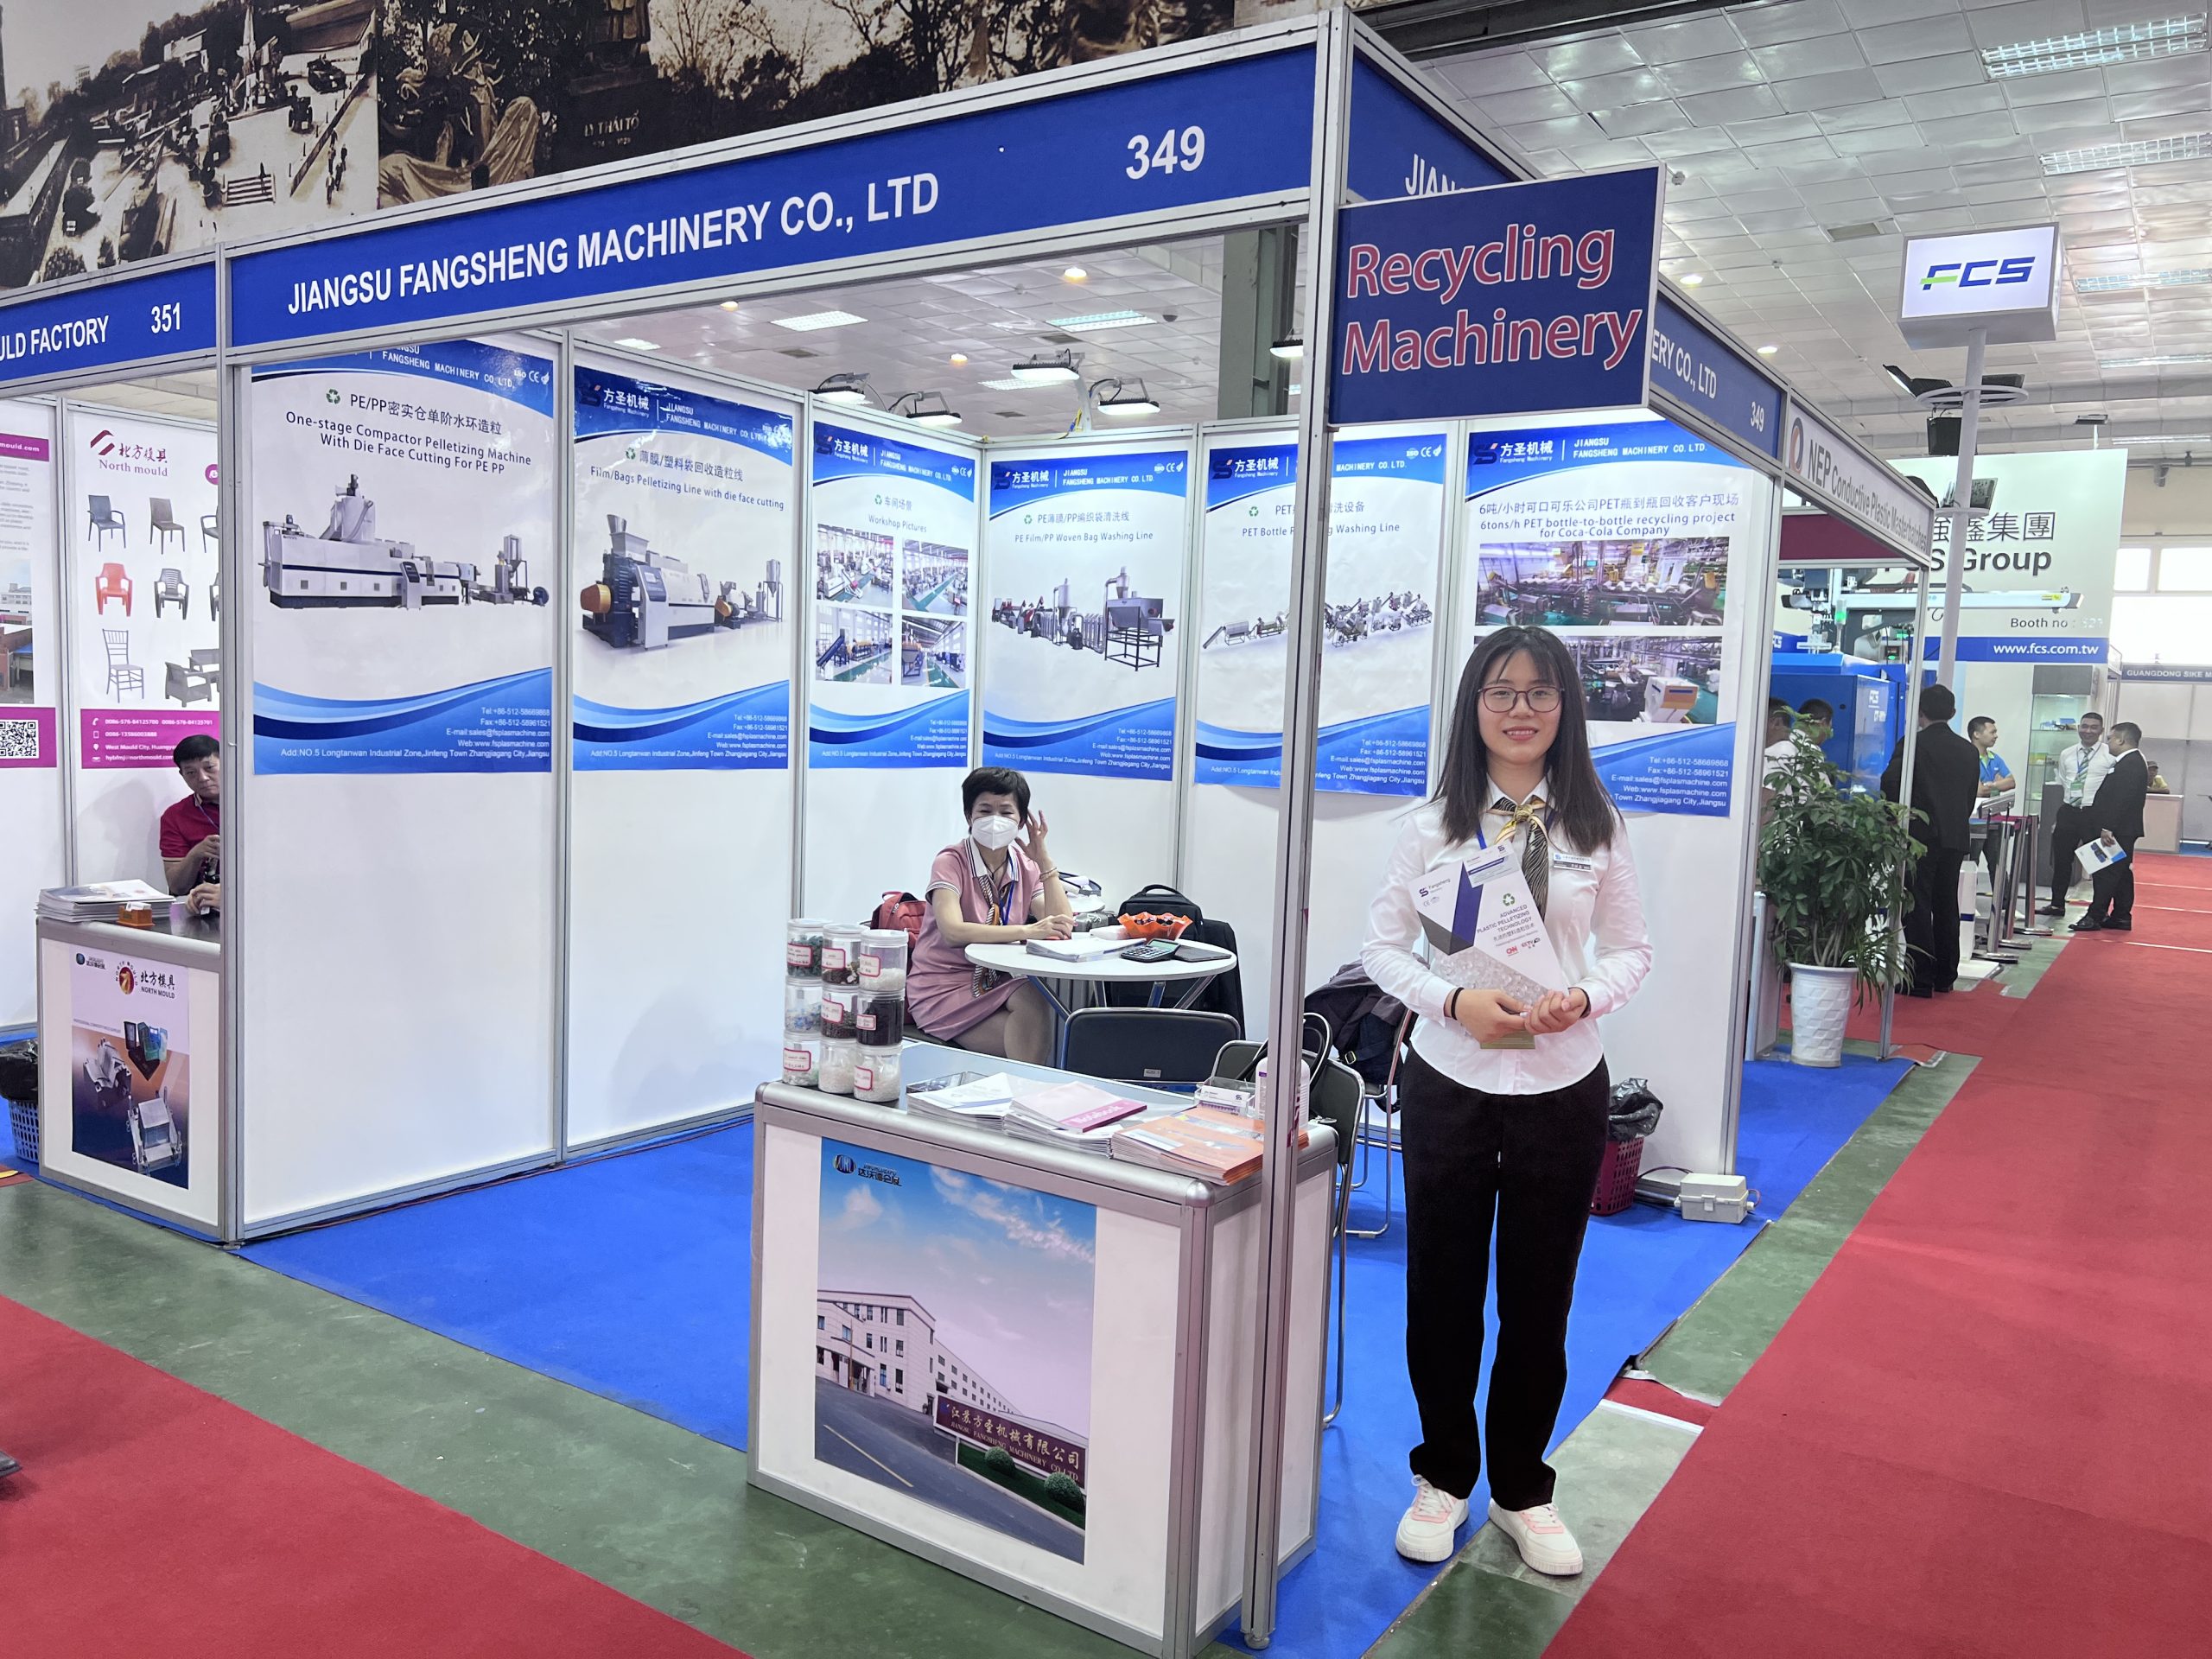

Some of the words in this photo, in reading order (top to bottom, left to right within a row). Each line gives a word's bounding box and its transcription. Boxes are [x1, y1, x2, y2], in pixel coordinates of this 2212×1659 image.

[288, 268, 391, 315] JIANGSU
[399, 238, 568, 297] FANGSHENG
[578, 200, 772, 270] MACHINERY
[780, 191, 853, 235] CO.,
[868, 173, 939, 222] LTD
[1125, 125, 1205, 180] 349
[1347, 223, 1614, 304] Recycling
[1920, 257, 2036, 290] FCS
[31, 315, 110, 355] FACTORY
[151, 302, 181, 334] 351
[1342, 308, 1643, 375] Machinery
[382, 351, 430, 370] FANGSHENG
[435, 363, 480, 380] MACHINERY
[1675, 347, 1696, 391] CO.,
[1698, 363, 1717, 400] LTD
[1750, 401, 1764, 433] 349
[604, 389, 649, 410] 方圣机械
[350, 393, 502, 436] PE/PP密实仓单阶水环造粒
[666, 413, 701, 429] FANGSHENG
[703, 422, 737, 435] MACHINERY
[286, 410, 353, 434] One-stage
[356, 423, 422, 448] Compactor
[425, 435, 484, 460] Pelletizing
[488, 447, 532, 466] Machine
[1573, 437, 1610, 448] JIANGSU
[119, 443, 168, 463] 北方模具
[320, 433, 350, 449] With
[354, 437, 374, 454] Die
[378, 442, 405, 459] Face
[409, 448, 451, 468] Cutting
[454, 456, 474, 470] For
[475, 458, 489, 473] PE
[492, 461, 505, 474] PP
[834, 438, 868, 457] 方圣机械
[1500, 440, 1554, 457] 方圣机械
[1573, 448, 1618, 458] FANGSHENG
[1623, 445, 1669, 456] MACHINERY
[99, 459, 130, 472] North
[135, 465, 168, 477] mould
[1235, 457, 1279, 473] 方圣机械
[1336, 462, 1375, 472] MACHINERY
[1012, 470, 1049, 484] 方圣机械
[1063, 477, 1094, 486] FANGSHENG
[590, 466, 635, 484] Film/Bags
[637, 474, 682, 494] Pelletizing
[683, 484, 702, 495] Line
[704, 486, 722, 499] with
[724, 490, 737, 502] die
[739, 493, 754, 505] face
[757, 497, 785, 512] cutting
[1808, 440, 1831, 489] NEP
[1832, 465, 1870, 516] Conductive
[1871, 492, 1890, 529] Plastic
[1891, 506, 1927, 552] Masterbatches
[868, 514, 900, 530] Workshop
[902, 519, 927, 532] Pictures
[1243, 528, 1257, 537] PET
[1261, 526, 1287, 537] Bottle
[1337, 524, 1376, 535] Washing
[1380, 523, 1400, 532] Line
[1480, 519, 1520, 530] 6tons/h
[1524, 518, 1542, 528] PET
[1546, 515, 1633, 528] bottle-to-bottle
[1637, 513, 1688, 525] recycling
[1693, 512, 1735, 524] project
[1014, 534, 1024, 543] PE
[1026, 533, 1054, 543] Film/PP
[1056, 532, 1082, 542] Woven
[1084, 532, 1098, 543] Bag
[1100, 531, 1134, 543] Washing
[1136, 531, 1154, 540] Line
[1540, 528, 1555, 537] for
[1558, 526, 1612, 537] Coca-Cola
[1616, 525, 1669, 537] Company
[1963, 548, 2052, 576] Group
[2011, 618, 2048, 628] Booth
[1993, 642, 2099, 655] www.fcs.com.tw
[1332, 772, 1348, 780] Town
[1614, 793, 1633, 802] Town
[1634, 795, 1681, 805] Zhangjiagang
[1499, 904, 1528, 918] ADVANCED
[1477, 921, 1497, 934] PLASTIC
[1497, 910, 1530, 926] PELLETIZING
[1497, 917, 1532, 933] TECHNOLOGY
[141, 970, 175, 988] 北方模具
[141, 986, 157, 995] NORTH
[158, 991, 175, 1000] MOULD
[950, 1421, 970, 1434] JIANGSU
[973, 1430, 1007, 1449] FANGSHENG
[1009, 1446, 1047, 1467] MACHINERY
[951, 1406, 1079, 1470] 江苏方圣机械有限公司
